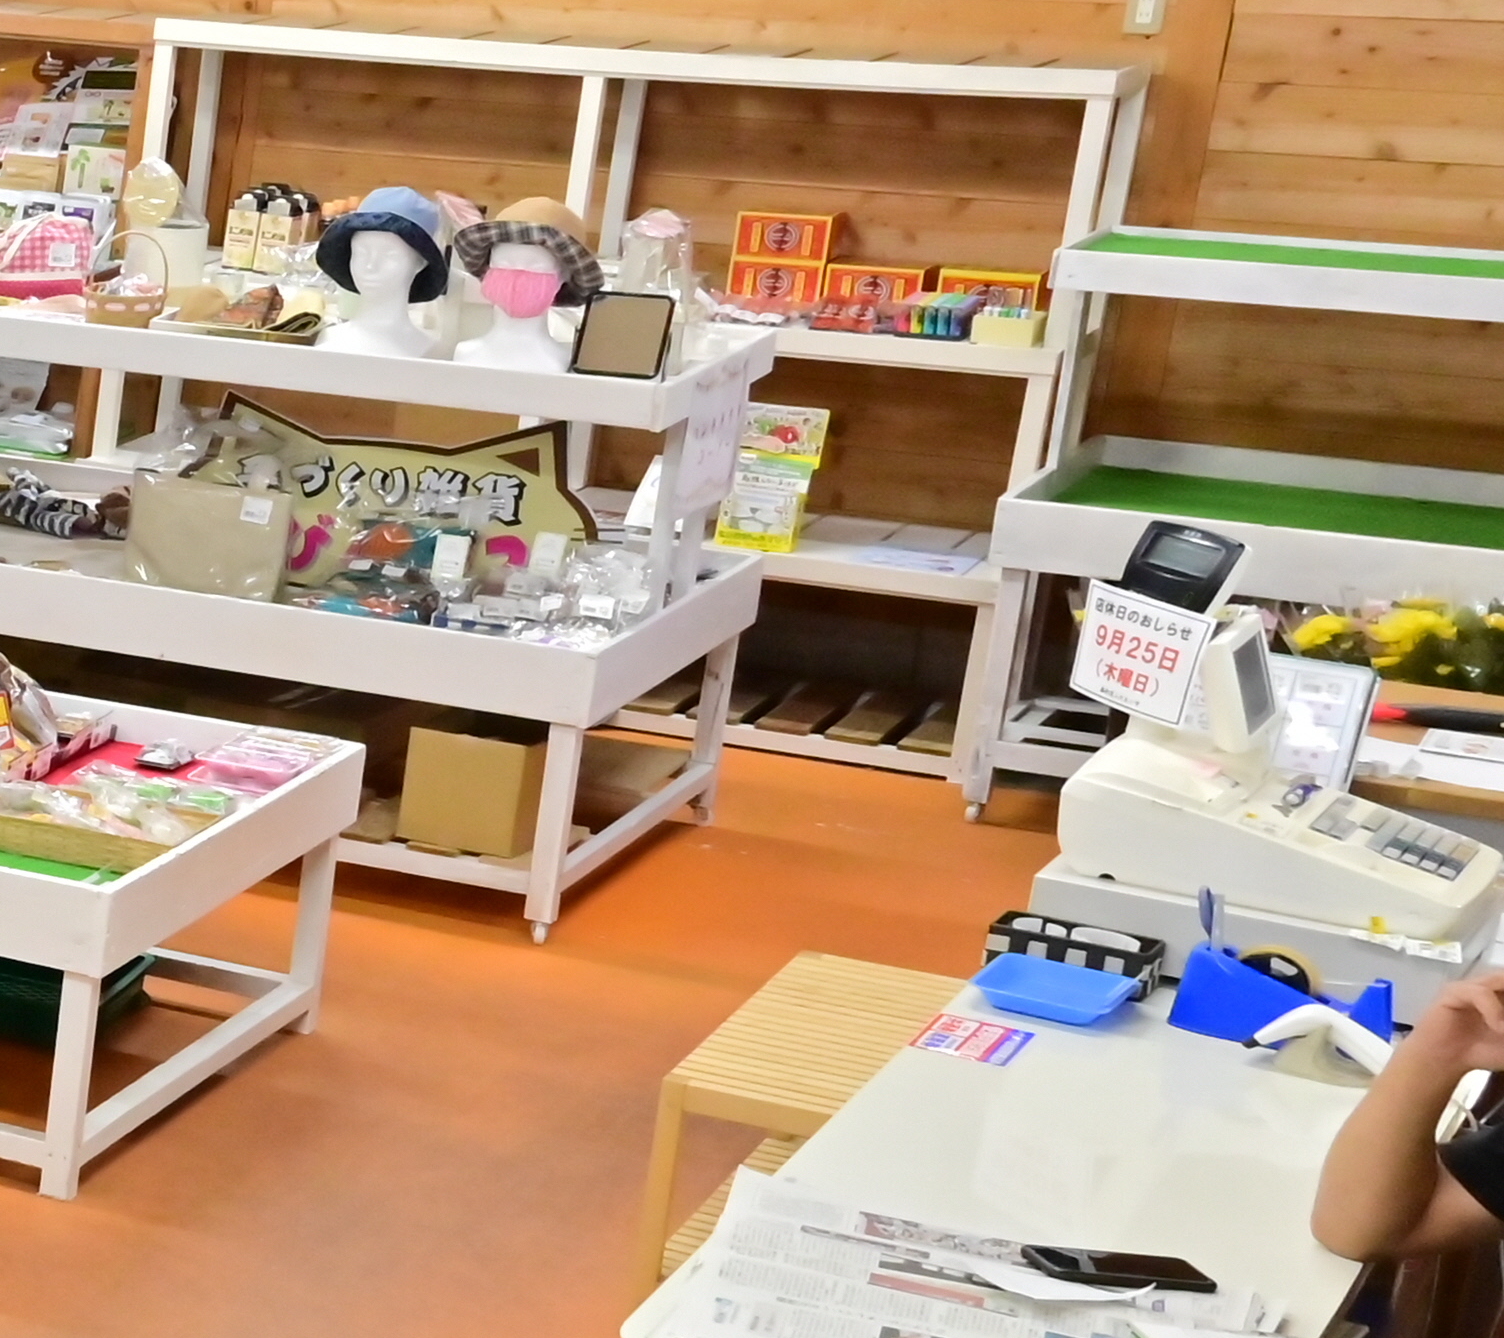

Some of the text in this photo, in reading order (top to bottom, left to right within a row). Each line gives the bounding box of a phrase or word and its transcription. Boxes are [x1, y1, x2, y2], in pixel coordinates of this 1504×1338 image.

[1095, 597, 1193, 642] 店休日のおしらせ
[1095, 624, 1180, 673] 9月25日
